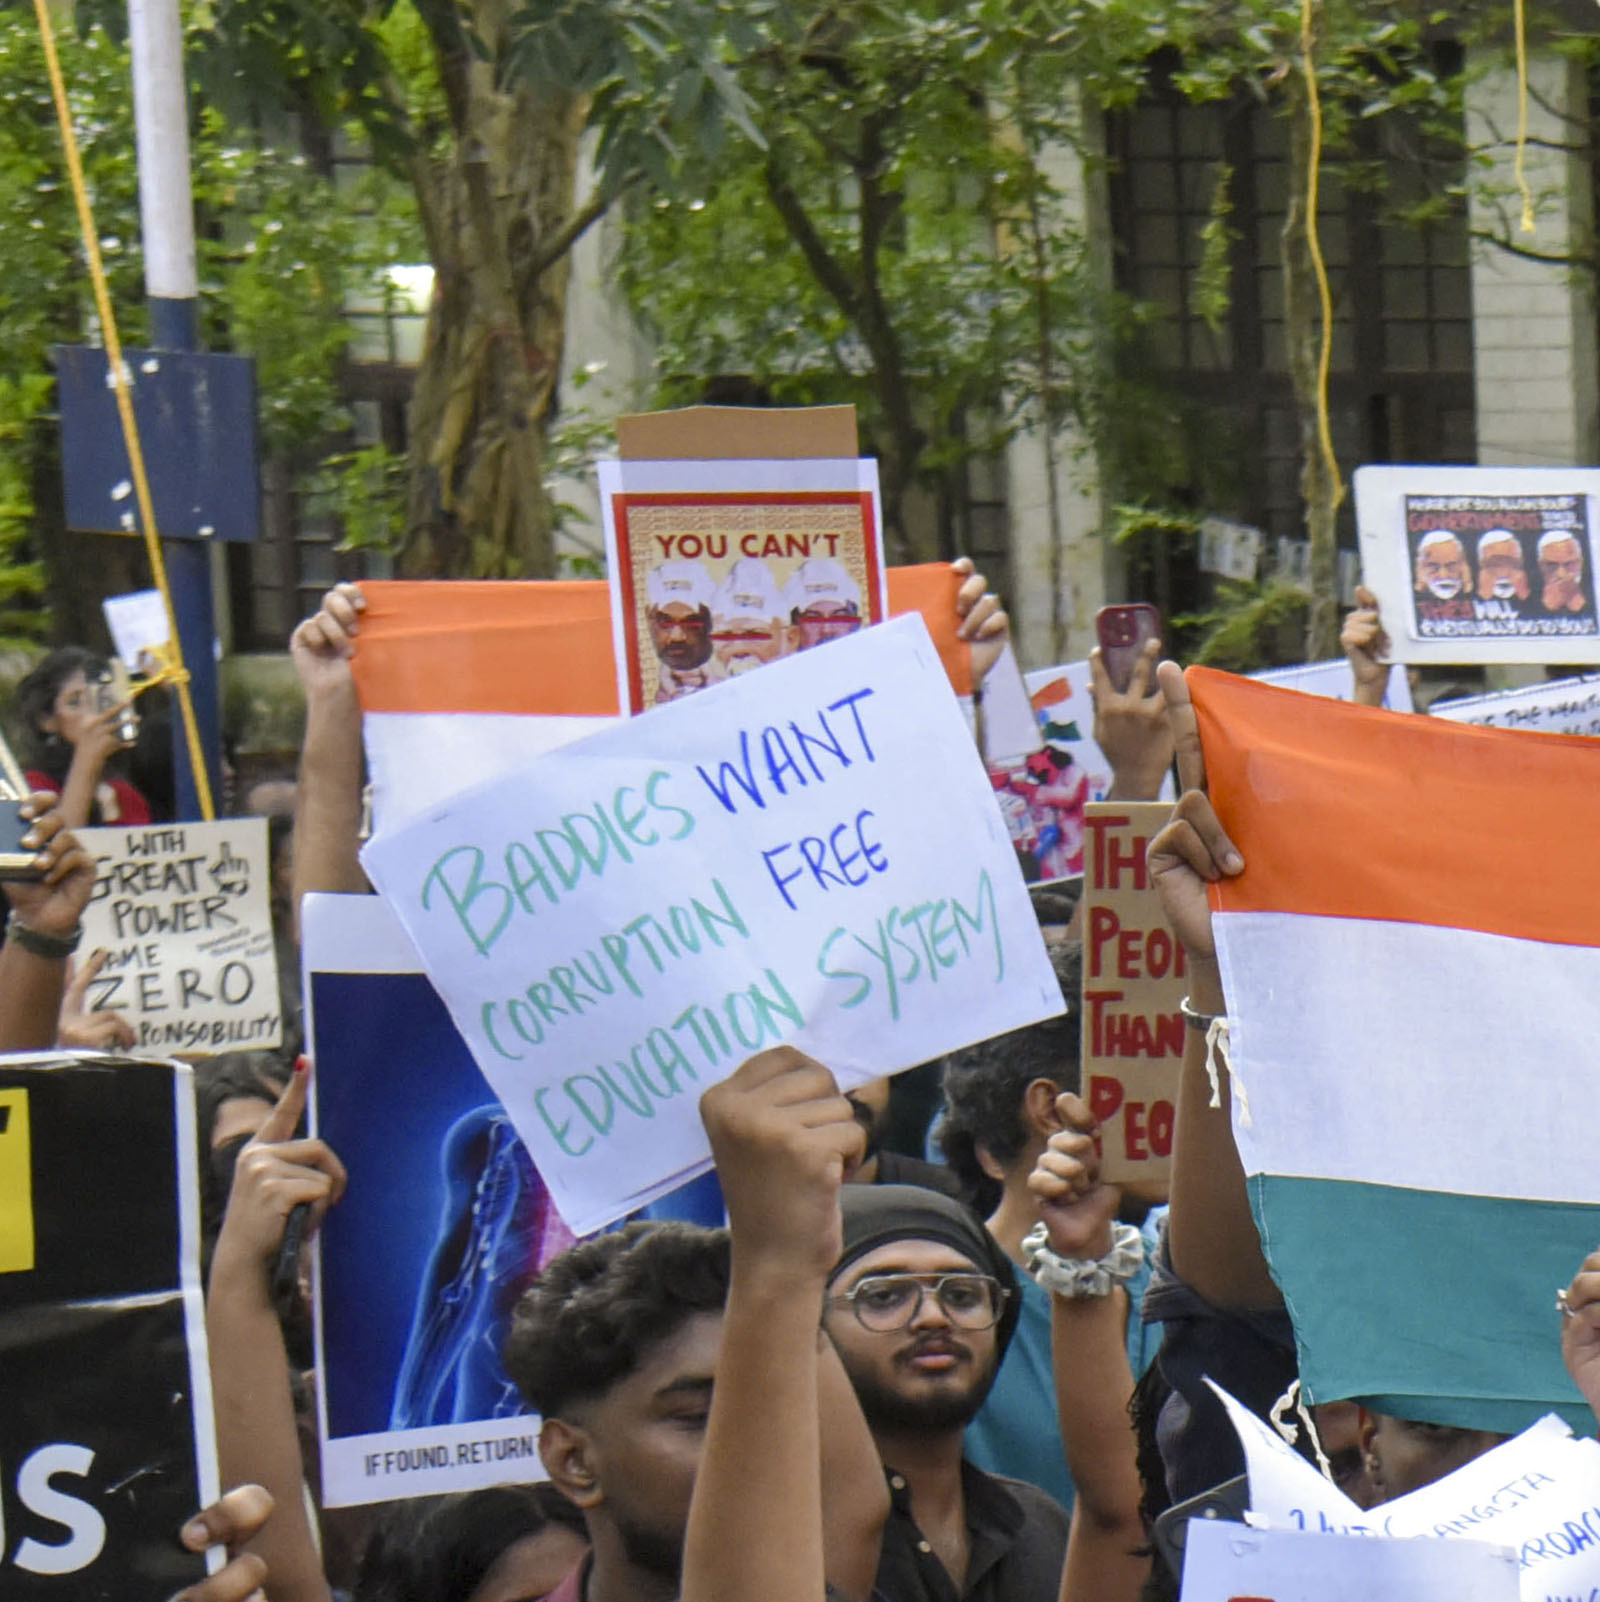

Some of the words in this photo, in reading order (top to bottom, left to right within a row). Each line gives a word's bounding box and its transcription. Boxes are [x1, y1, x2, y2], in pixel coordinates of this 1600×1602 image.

[657, 535, 727, 558] YOU
[740, 533, 841, 558] CAN'T
[127, 831, 185, 855] WITH
[422, 771, 694, 957] BADDIES
[696, 688, 875, 814] WANT
[1084, 816, 1153, 890] TH
[112, 895, 238, 938] POWER
[480, 876, 751, 1062] CORRUPTION
[761, 809, 890, 911] FREE
[1089, 905, 1187, 979] PEO
[92, 943, 160, 970] AME
[88, 961, 254, 1013] ZERO
[533, 968, 806, 1158] EDUCATION
[816, 868, 1006, 1022] SYSTEM
[139, 1014, 280, 1046] PONSOBILITY
[1086, 991, 1185, 1058] THAN
[1090, 1075, 1176, 1161] PEO
[365, 1453, 381, 1476] IF
[457, 1435, 534, 1465] RETURN
